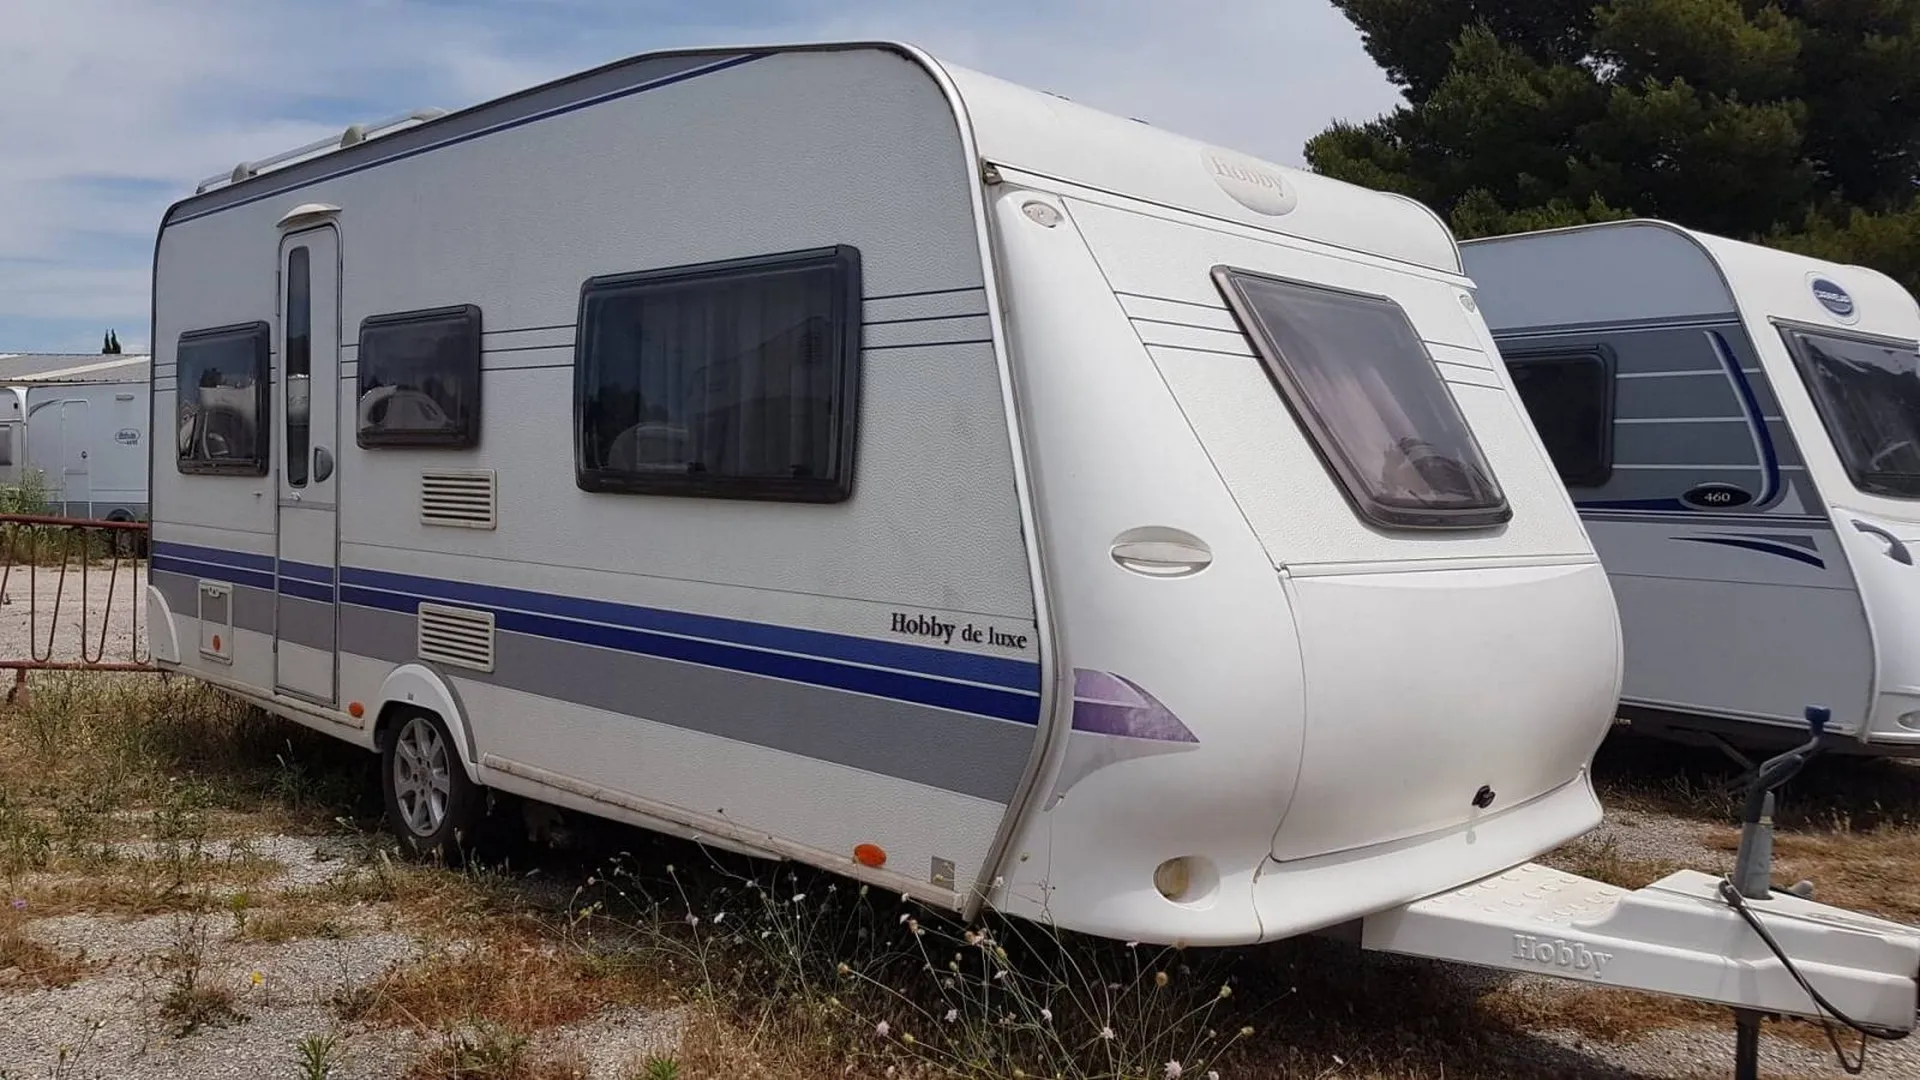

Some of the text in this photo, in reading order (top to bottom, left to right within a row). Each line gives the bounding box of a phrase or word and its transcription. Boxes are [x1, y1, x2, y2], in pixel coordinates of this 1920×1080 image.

[1704, 492, 1730, 502] 460
[891, 612, 1027, 649] Hobby de luxe
[1512, 933, 1613, 978] Hobby
